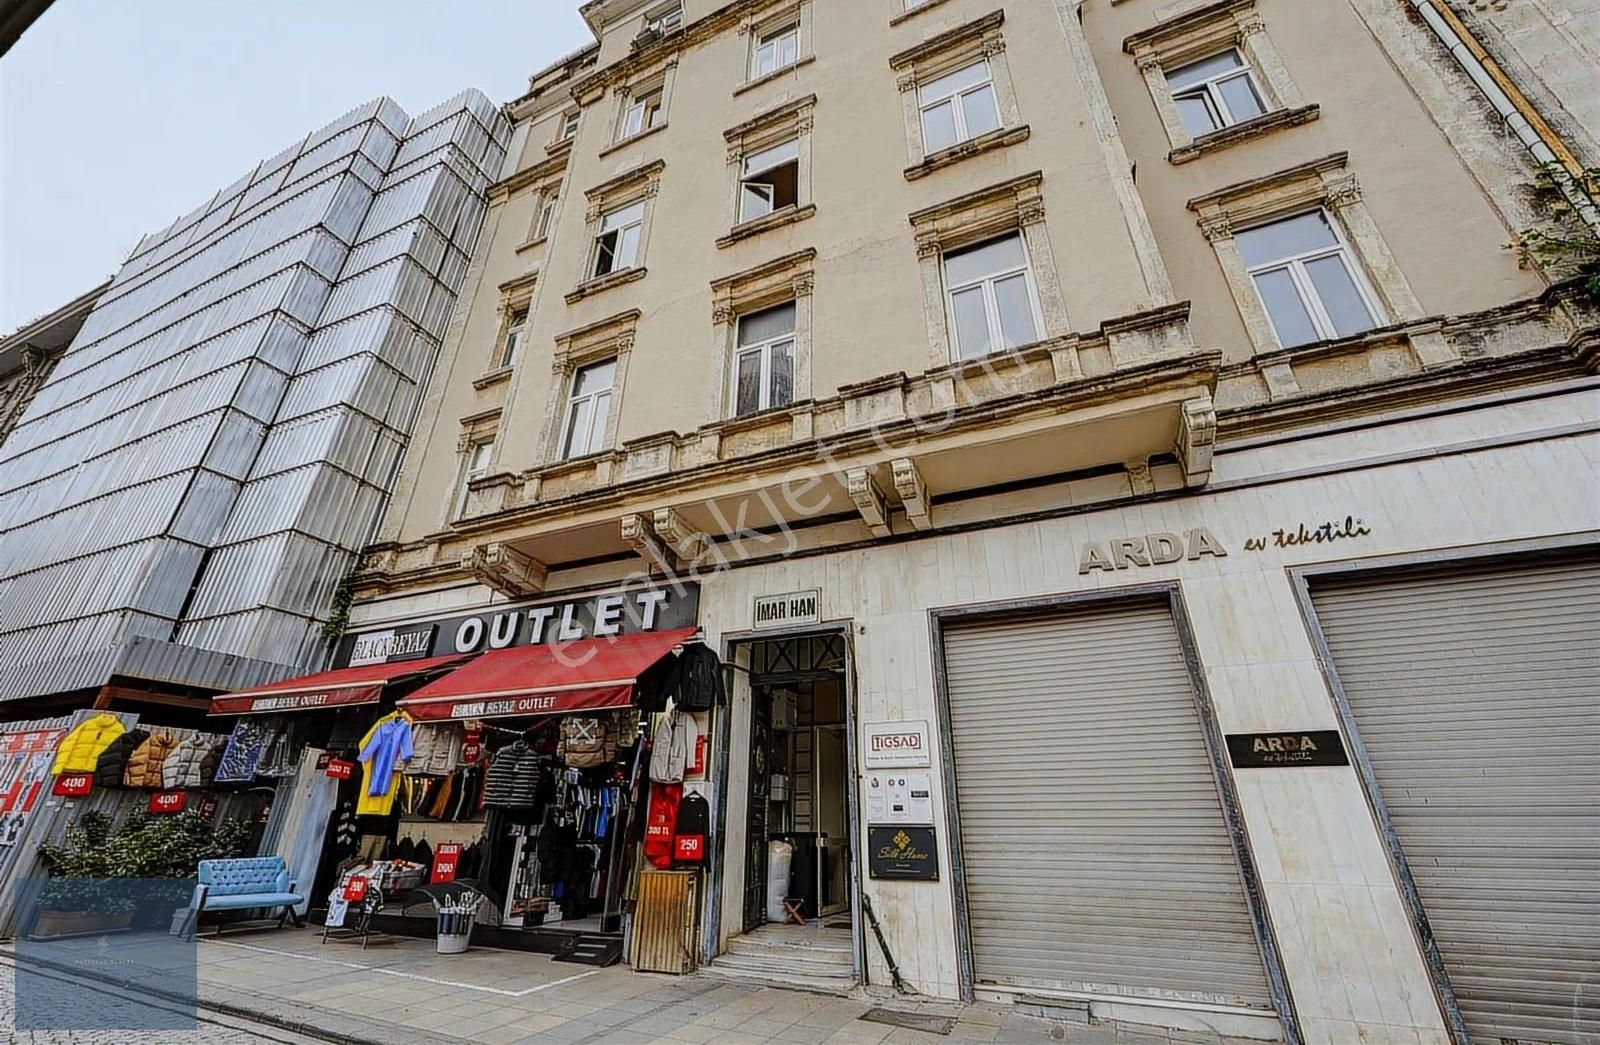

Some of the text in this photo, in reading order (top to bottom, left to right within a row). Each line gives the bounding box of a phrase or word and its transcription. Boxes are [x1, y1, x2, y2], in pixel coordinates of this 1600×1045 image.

[1079, 515, 1371, 575] ARDA ev tekstili
[790, 597, 816, 617] HAN
[455, 590, 667, 653] OUTLET
[519, 696, 556, 710] OUTLET
[1253, 735, 1318, 752] ARDA
[62, 777, 86, 788] 400
[157, 794, 179, 804] 400
[680, 839, 698, 850] 250
